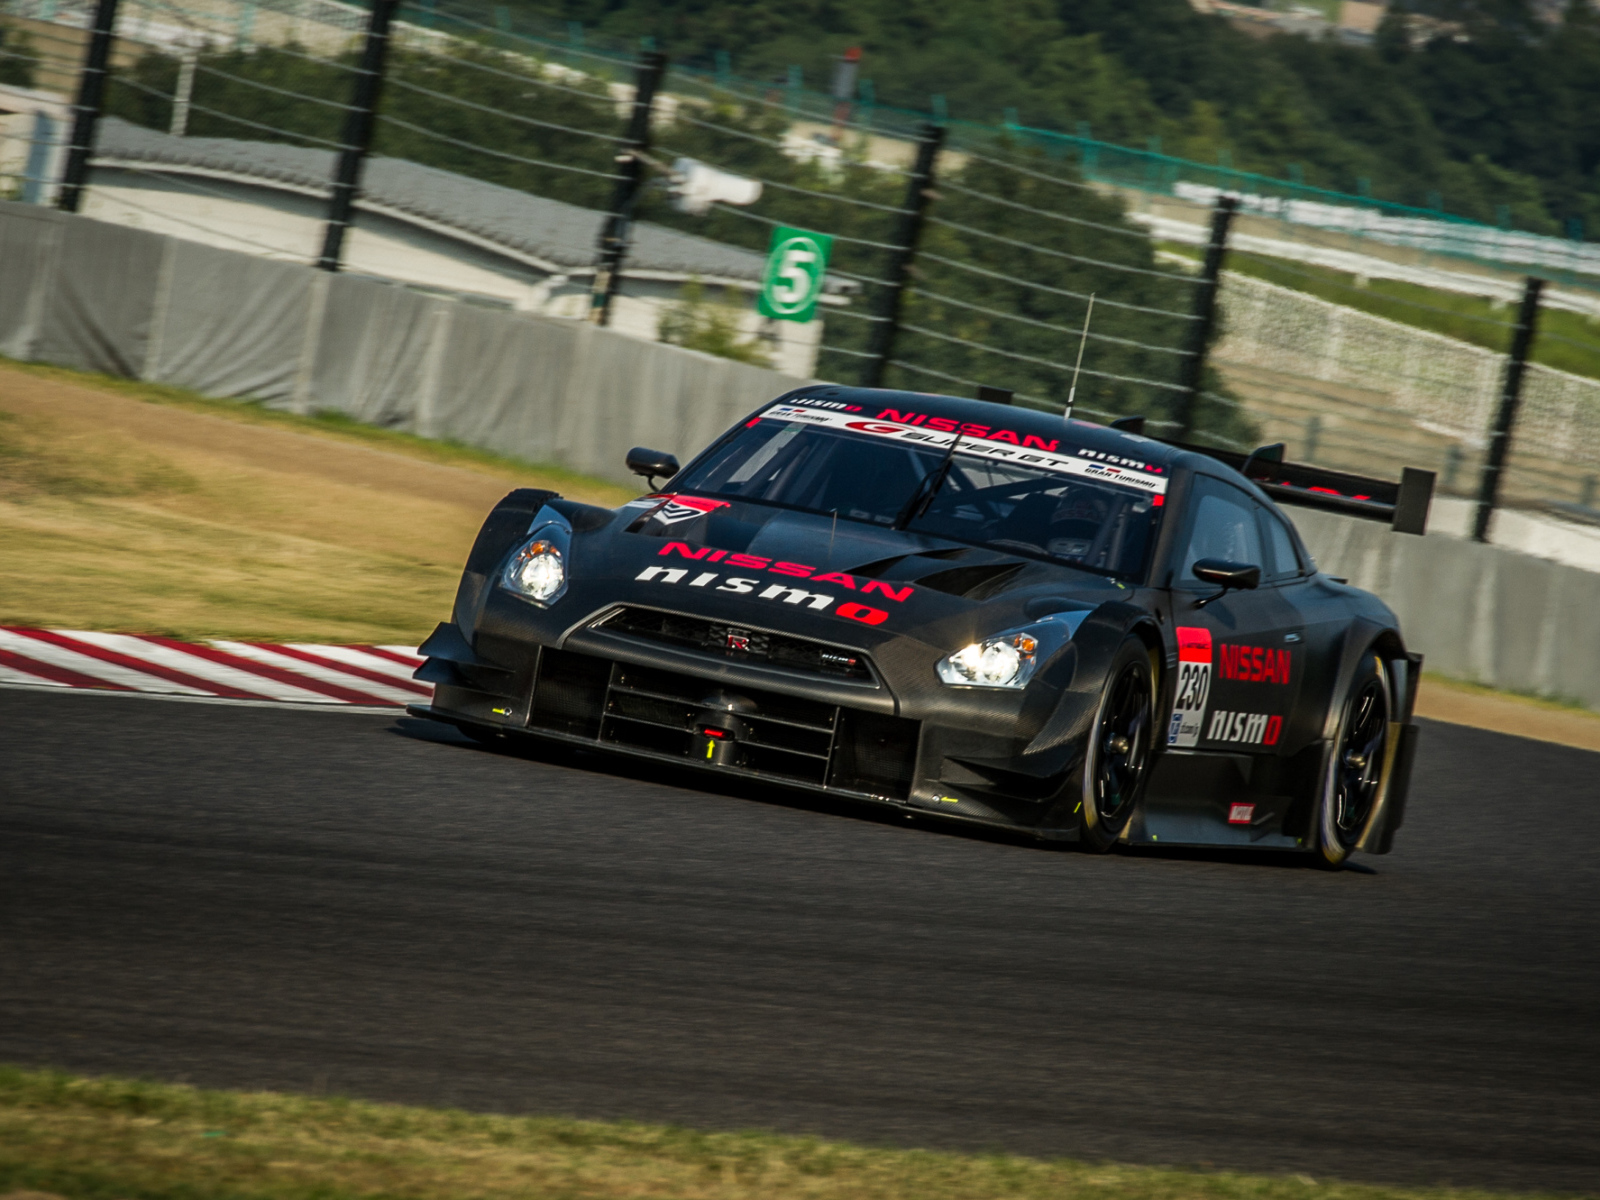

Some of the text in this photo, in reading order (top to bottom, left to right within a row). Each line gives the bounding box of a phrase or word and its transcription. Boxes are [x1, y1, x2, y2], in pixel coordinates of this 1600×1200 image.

[772, 249, 817, 303] 5
[875, 408, 1060, 452] NISSAN
[900, 432, 1016, 457] SUPER
[1018, 454, 1069, 467] GT
[1084, 468, 1112, 477] GRAN
[658, 542, 915, 602] NISSAN
[635, 566, 889, 626] nismo
[1219, 643, 1291, 684] NISSAN
[1175, 664, 1209, 711] 230
[1206, 710, 1283, 746] nismo
